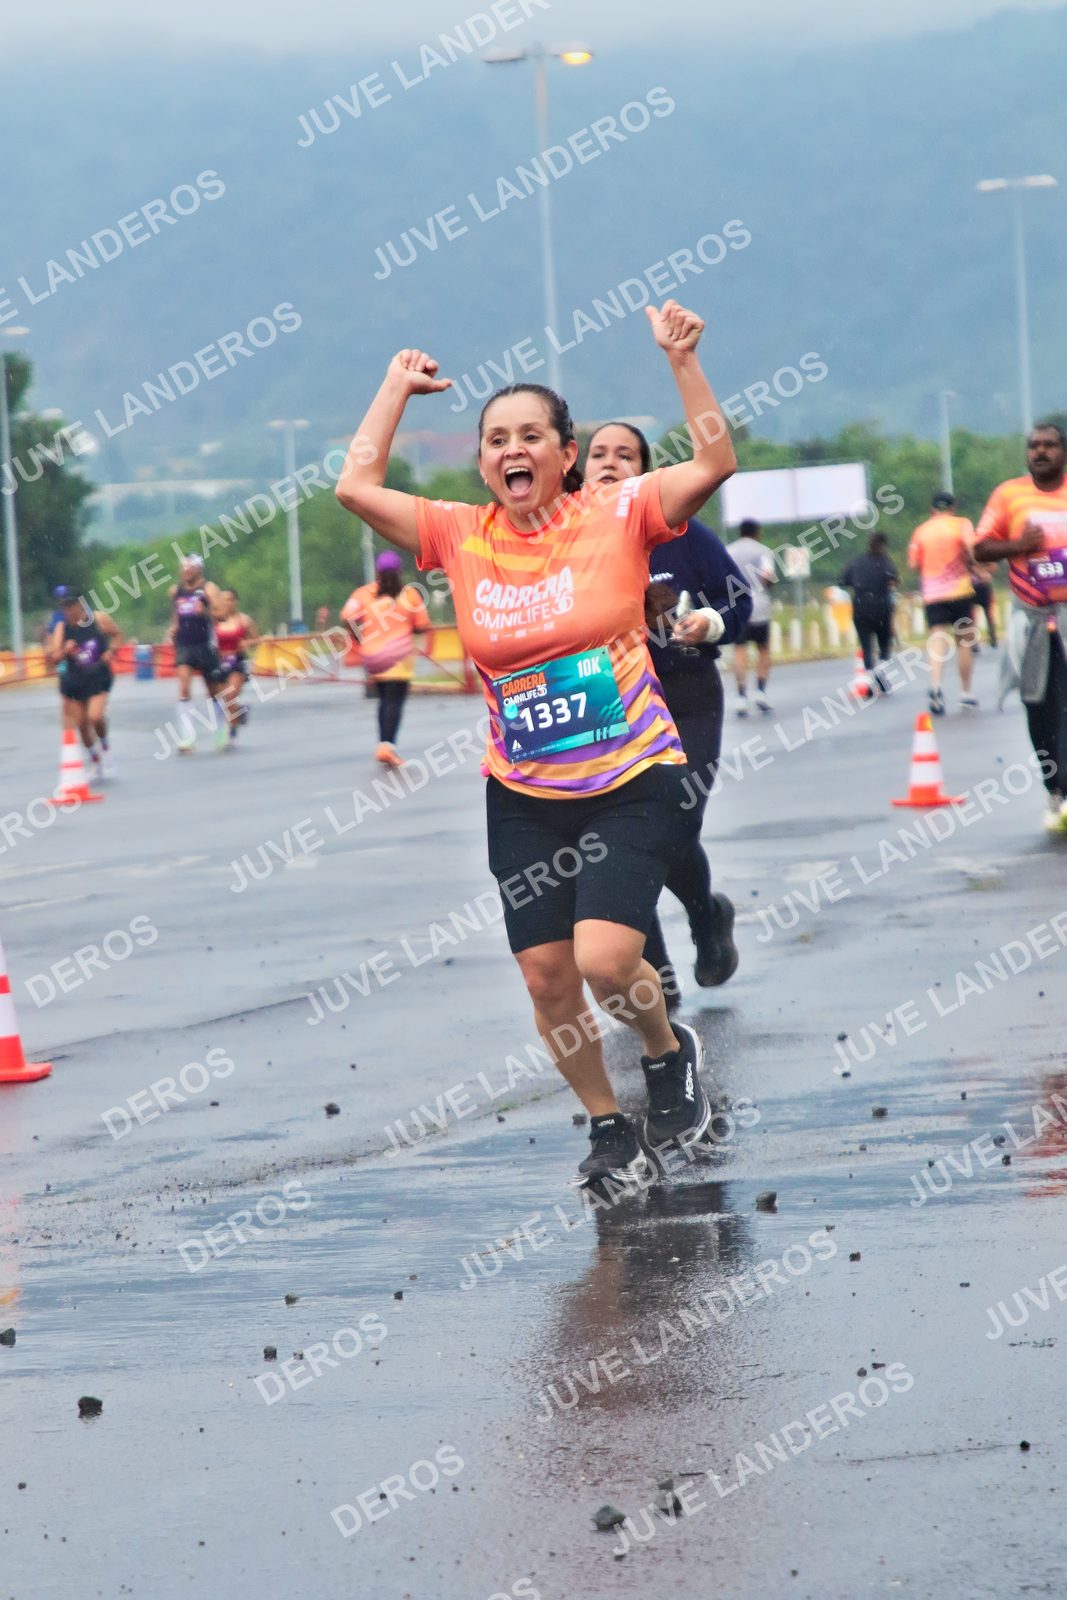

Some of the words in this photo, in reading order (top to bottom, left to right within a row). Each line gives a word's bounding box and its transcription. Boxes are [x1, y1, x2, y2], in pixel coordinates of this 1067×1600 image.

[476, 566, 574, 610] CARRERA
[502, 671, 546, 698] CARRERA
[577, 656, 601, 678] 10K
[520, 691, 587, 732] 1337
[685, 1062, 695, 1102] HOKA
